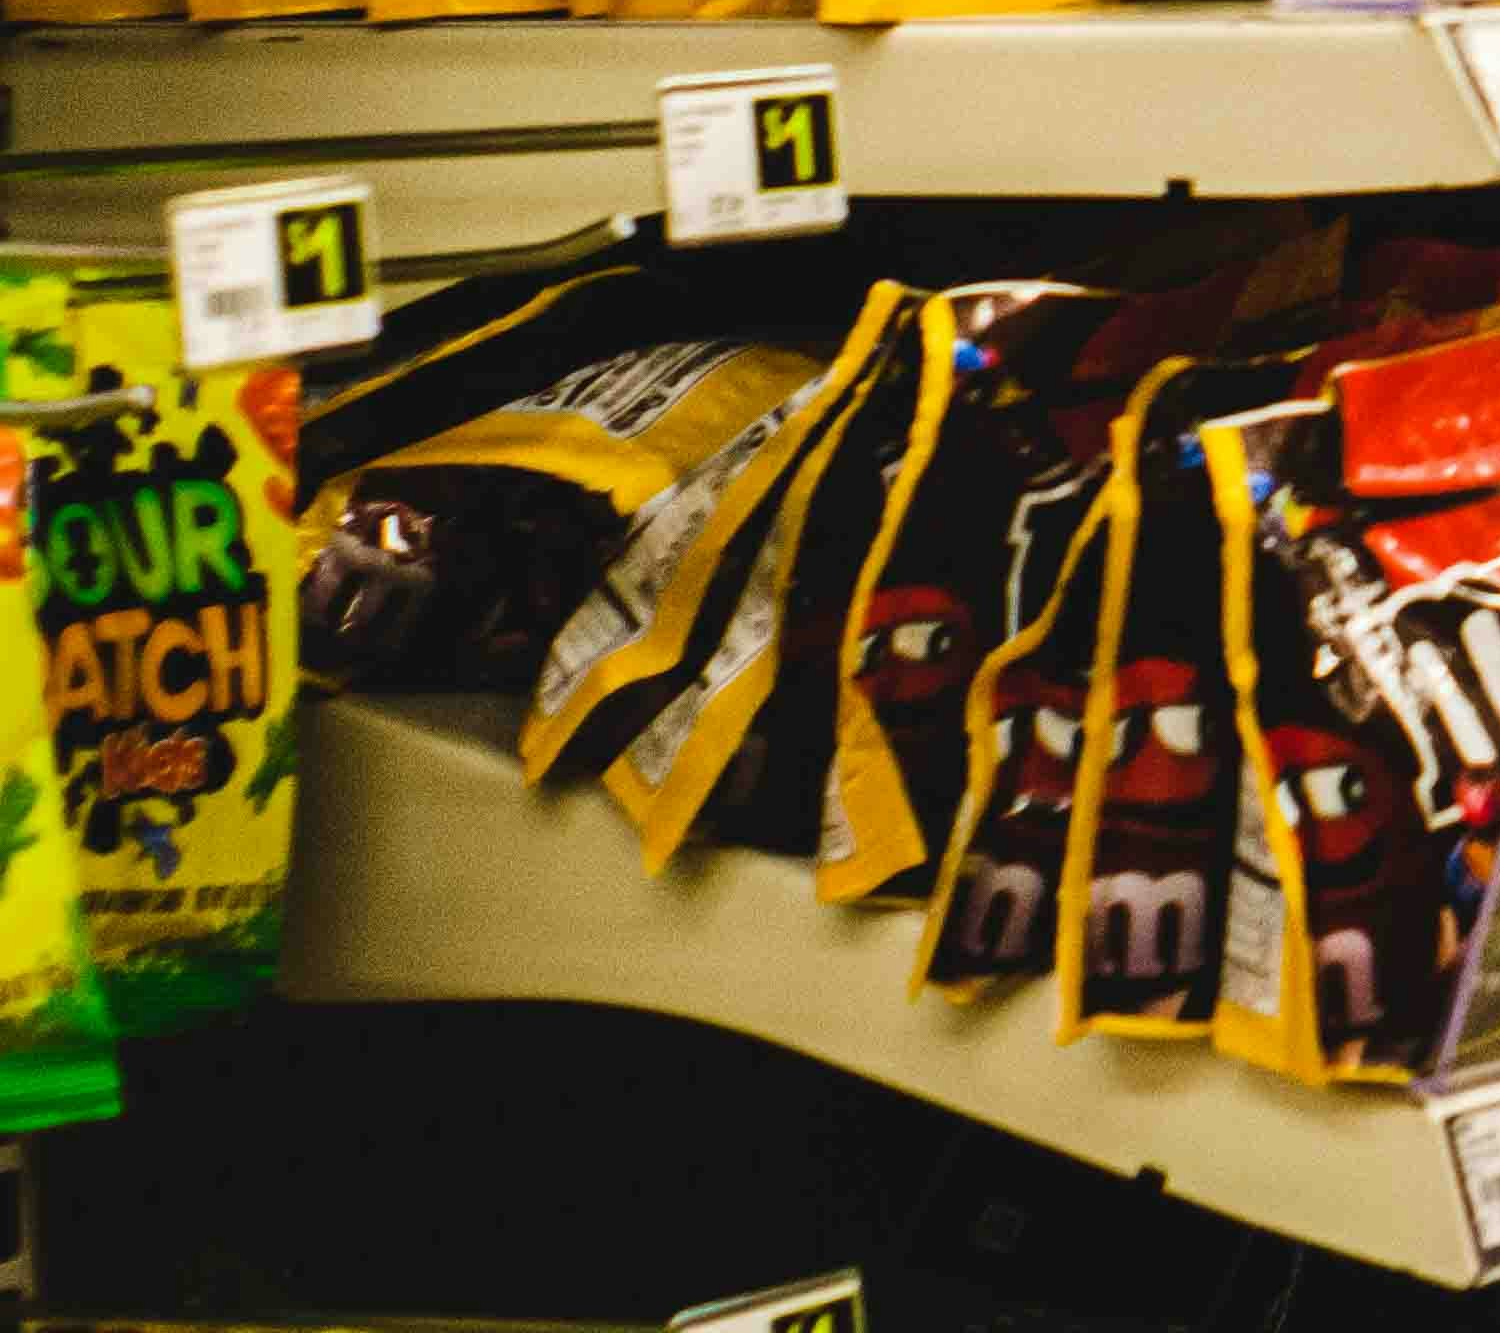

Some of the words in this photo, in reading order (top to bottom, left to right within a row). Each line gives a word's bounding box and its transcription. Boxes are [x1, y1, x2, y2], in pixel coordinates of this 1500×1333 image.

[763, 104, 816, 186] $1
[288, 207, 349, 301] $1
[30, 478, 249, 605] OUR
[46, 601, 267, 723] ATCH
